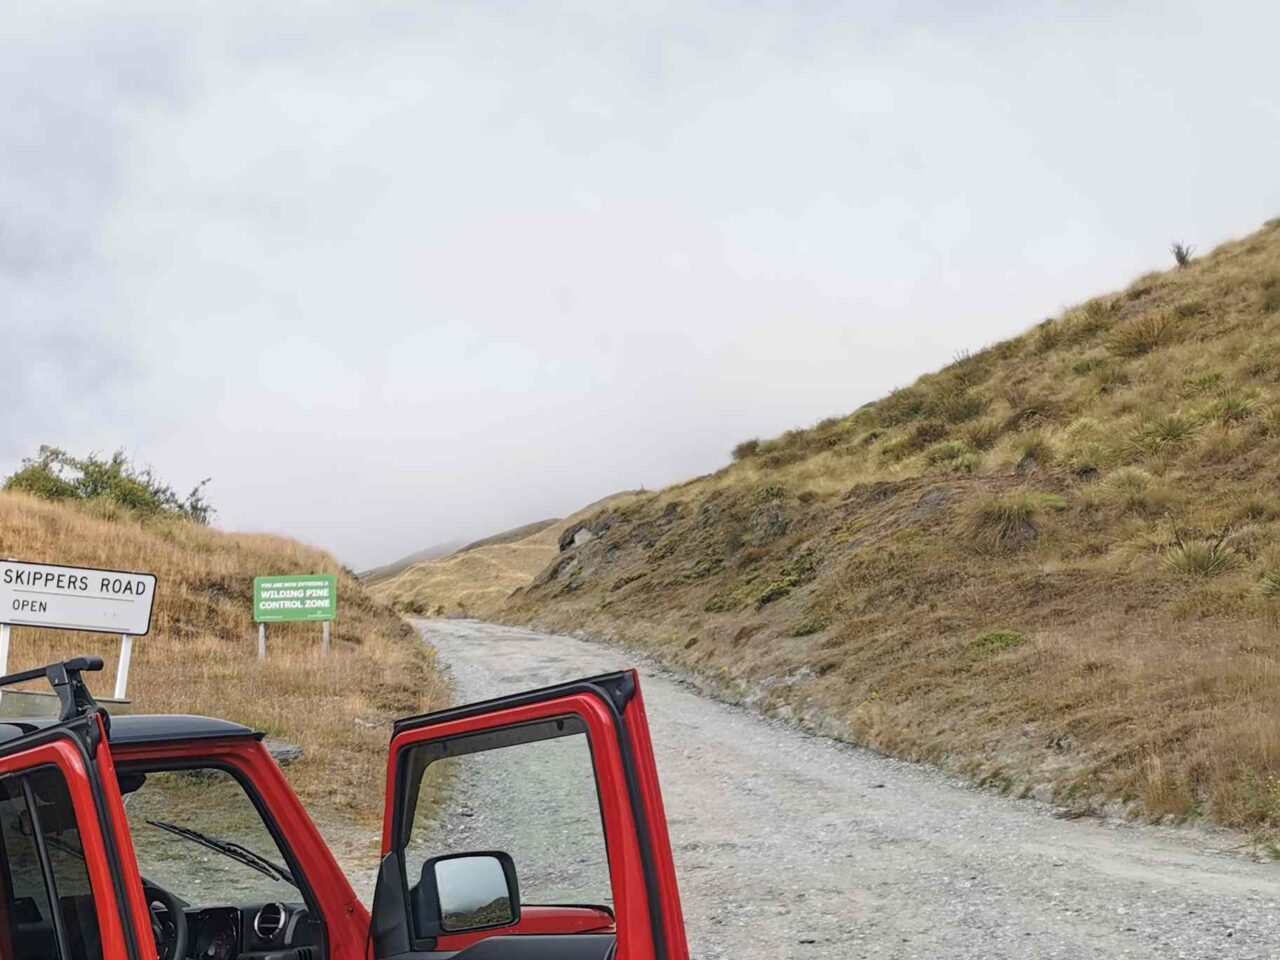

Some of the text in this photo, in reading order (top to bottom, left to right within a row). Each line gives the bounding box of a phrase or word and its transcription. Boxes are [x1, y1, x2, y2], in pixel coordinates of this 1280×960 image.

[3, 568, 146, 596] SKIPPERS ROAD
[261, 588, 329, 598] WILDING PINE
[12, 599, 47, 612] OPEN
[260, 599, 330, 609] CONTROL ZONE
